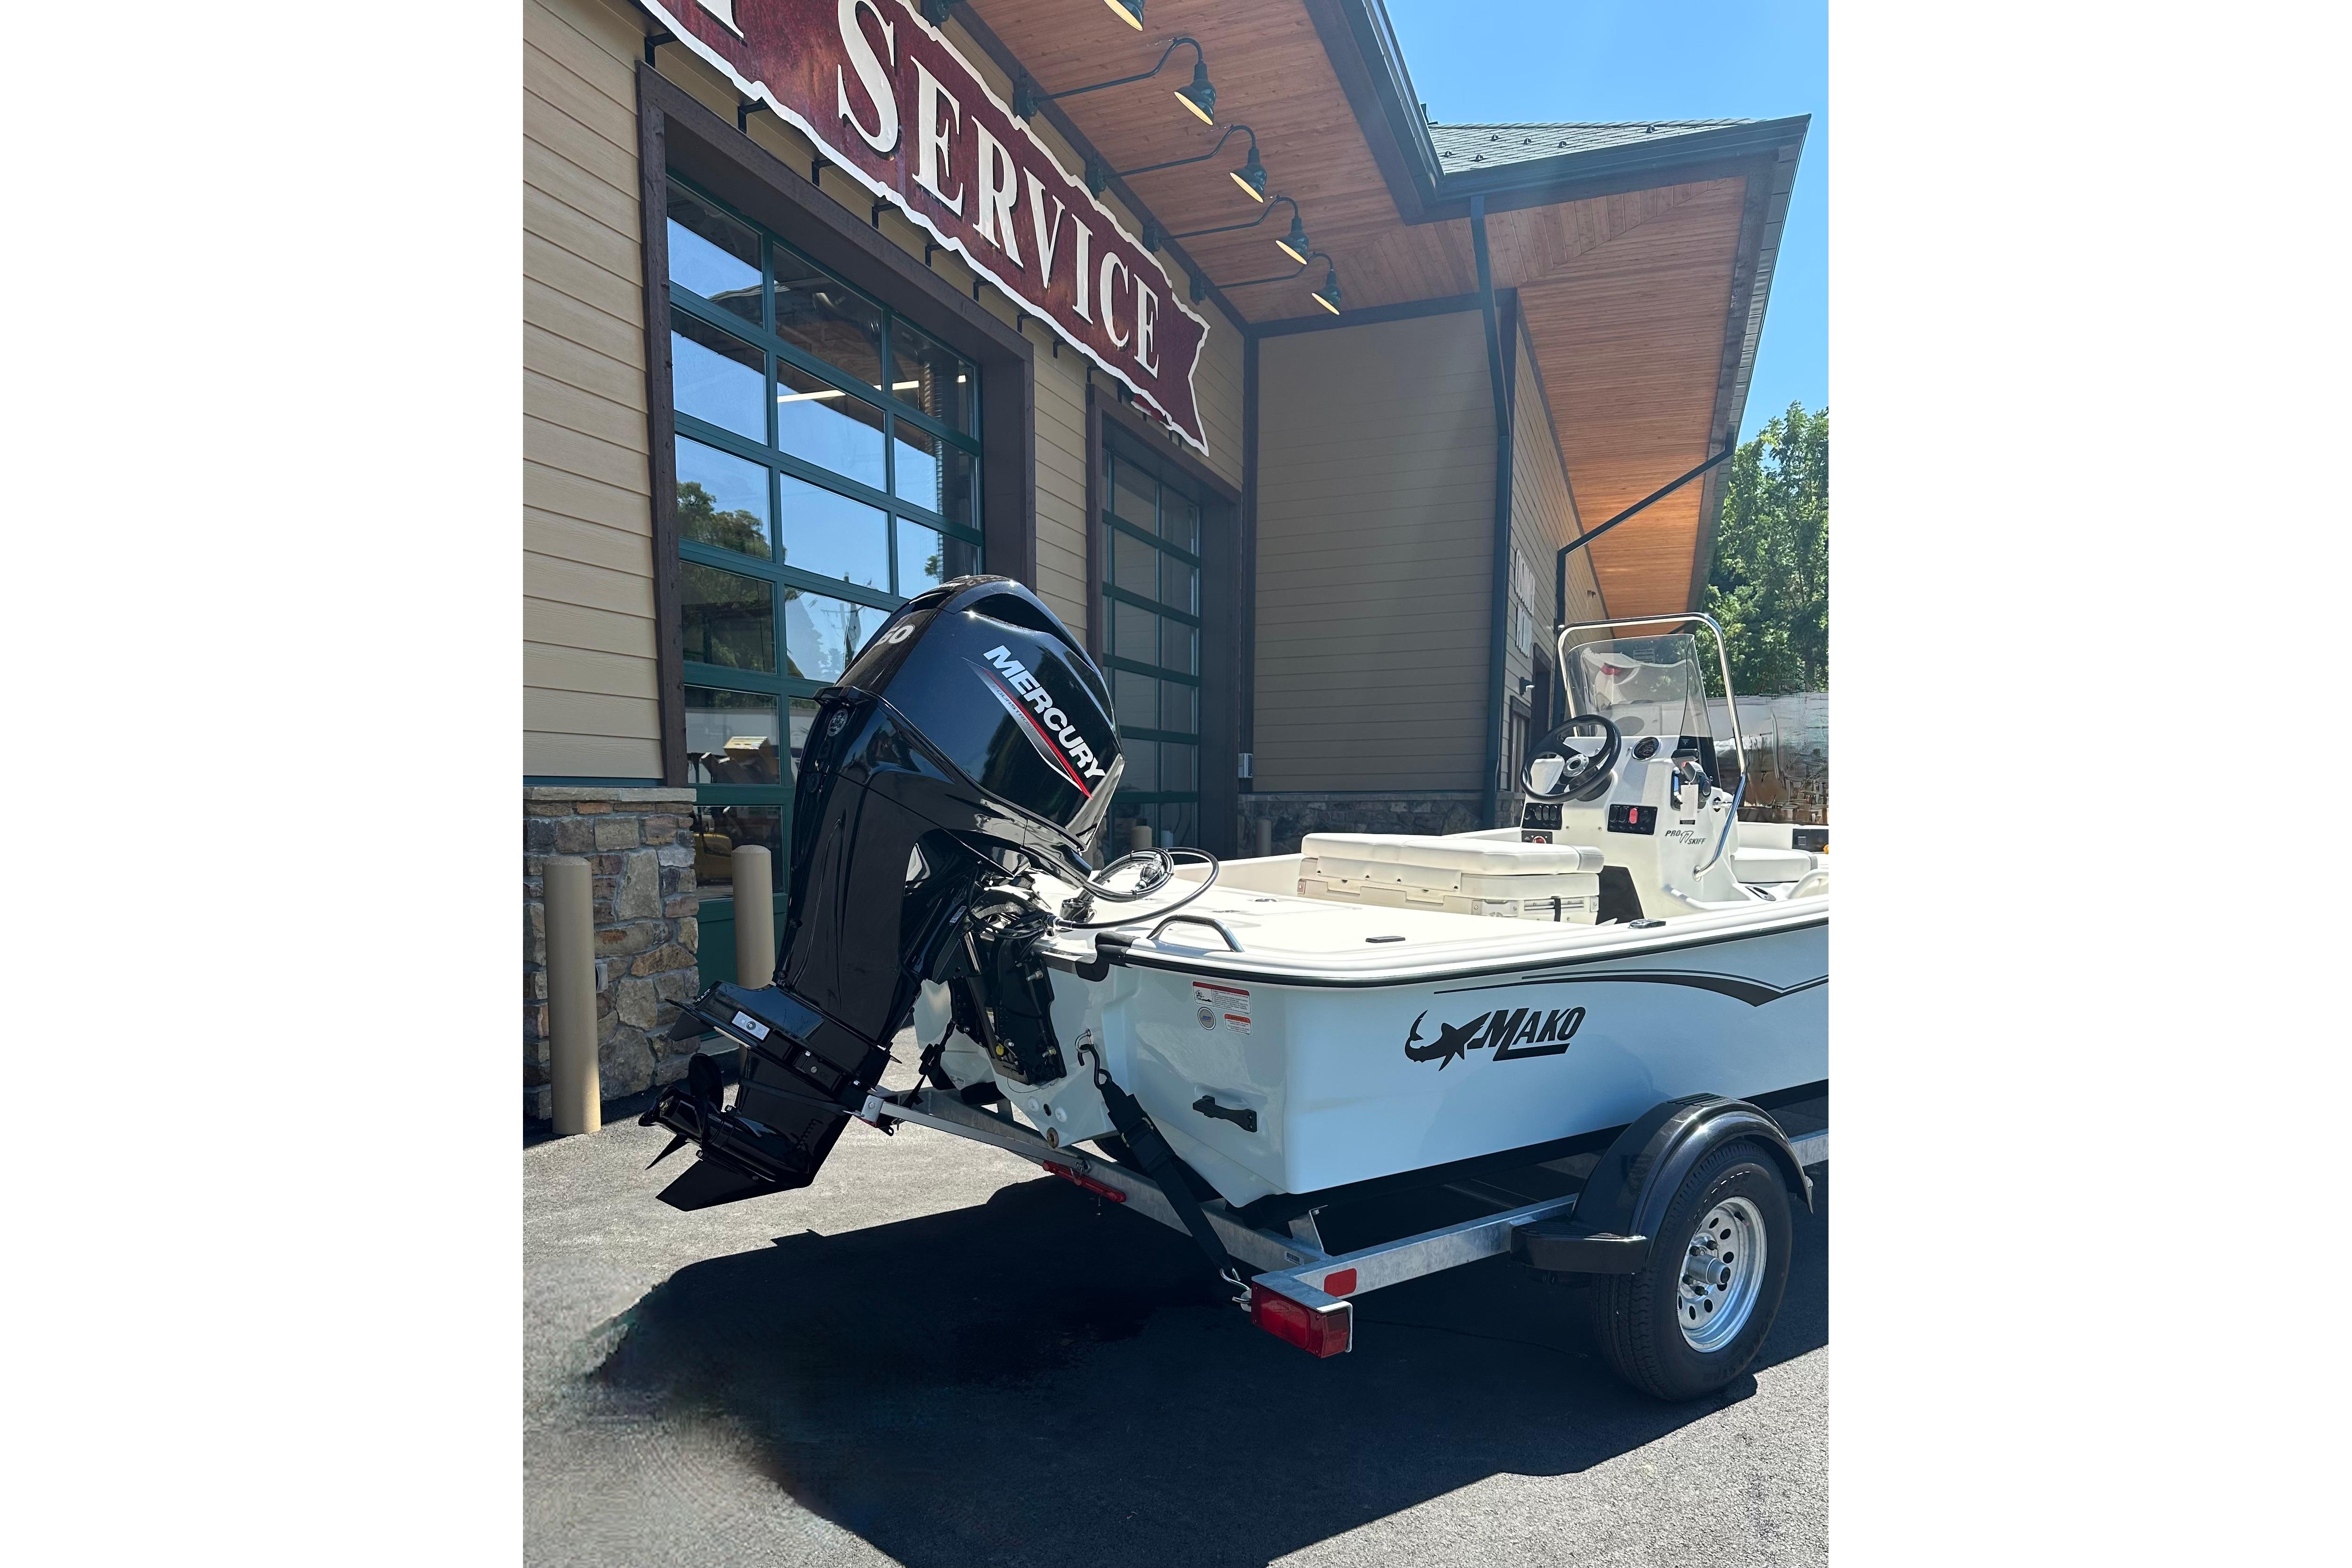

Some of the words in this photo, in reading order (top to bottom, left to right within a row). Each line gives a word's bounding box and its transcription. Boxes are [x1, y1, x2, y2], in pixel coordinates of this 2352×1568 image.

[837, 0, 1159, 379] SERVICE
[983, 645, 1106, 779] MERCURY
[1466, 1006, 1586, 1062] MAKO
